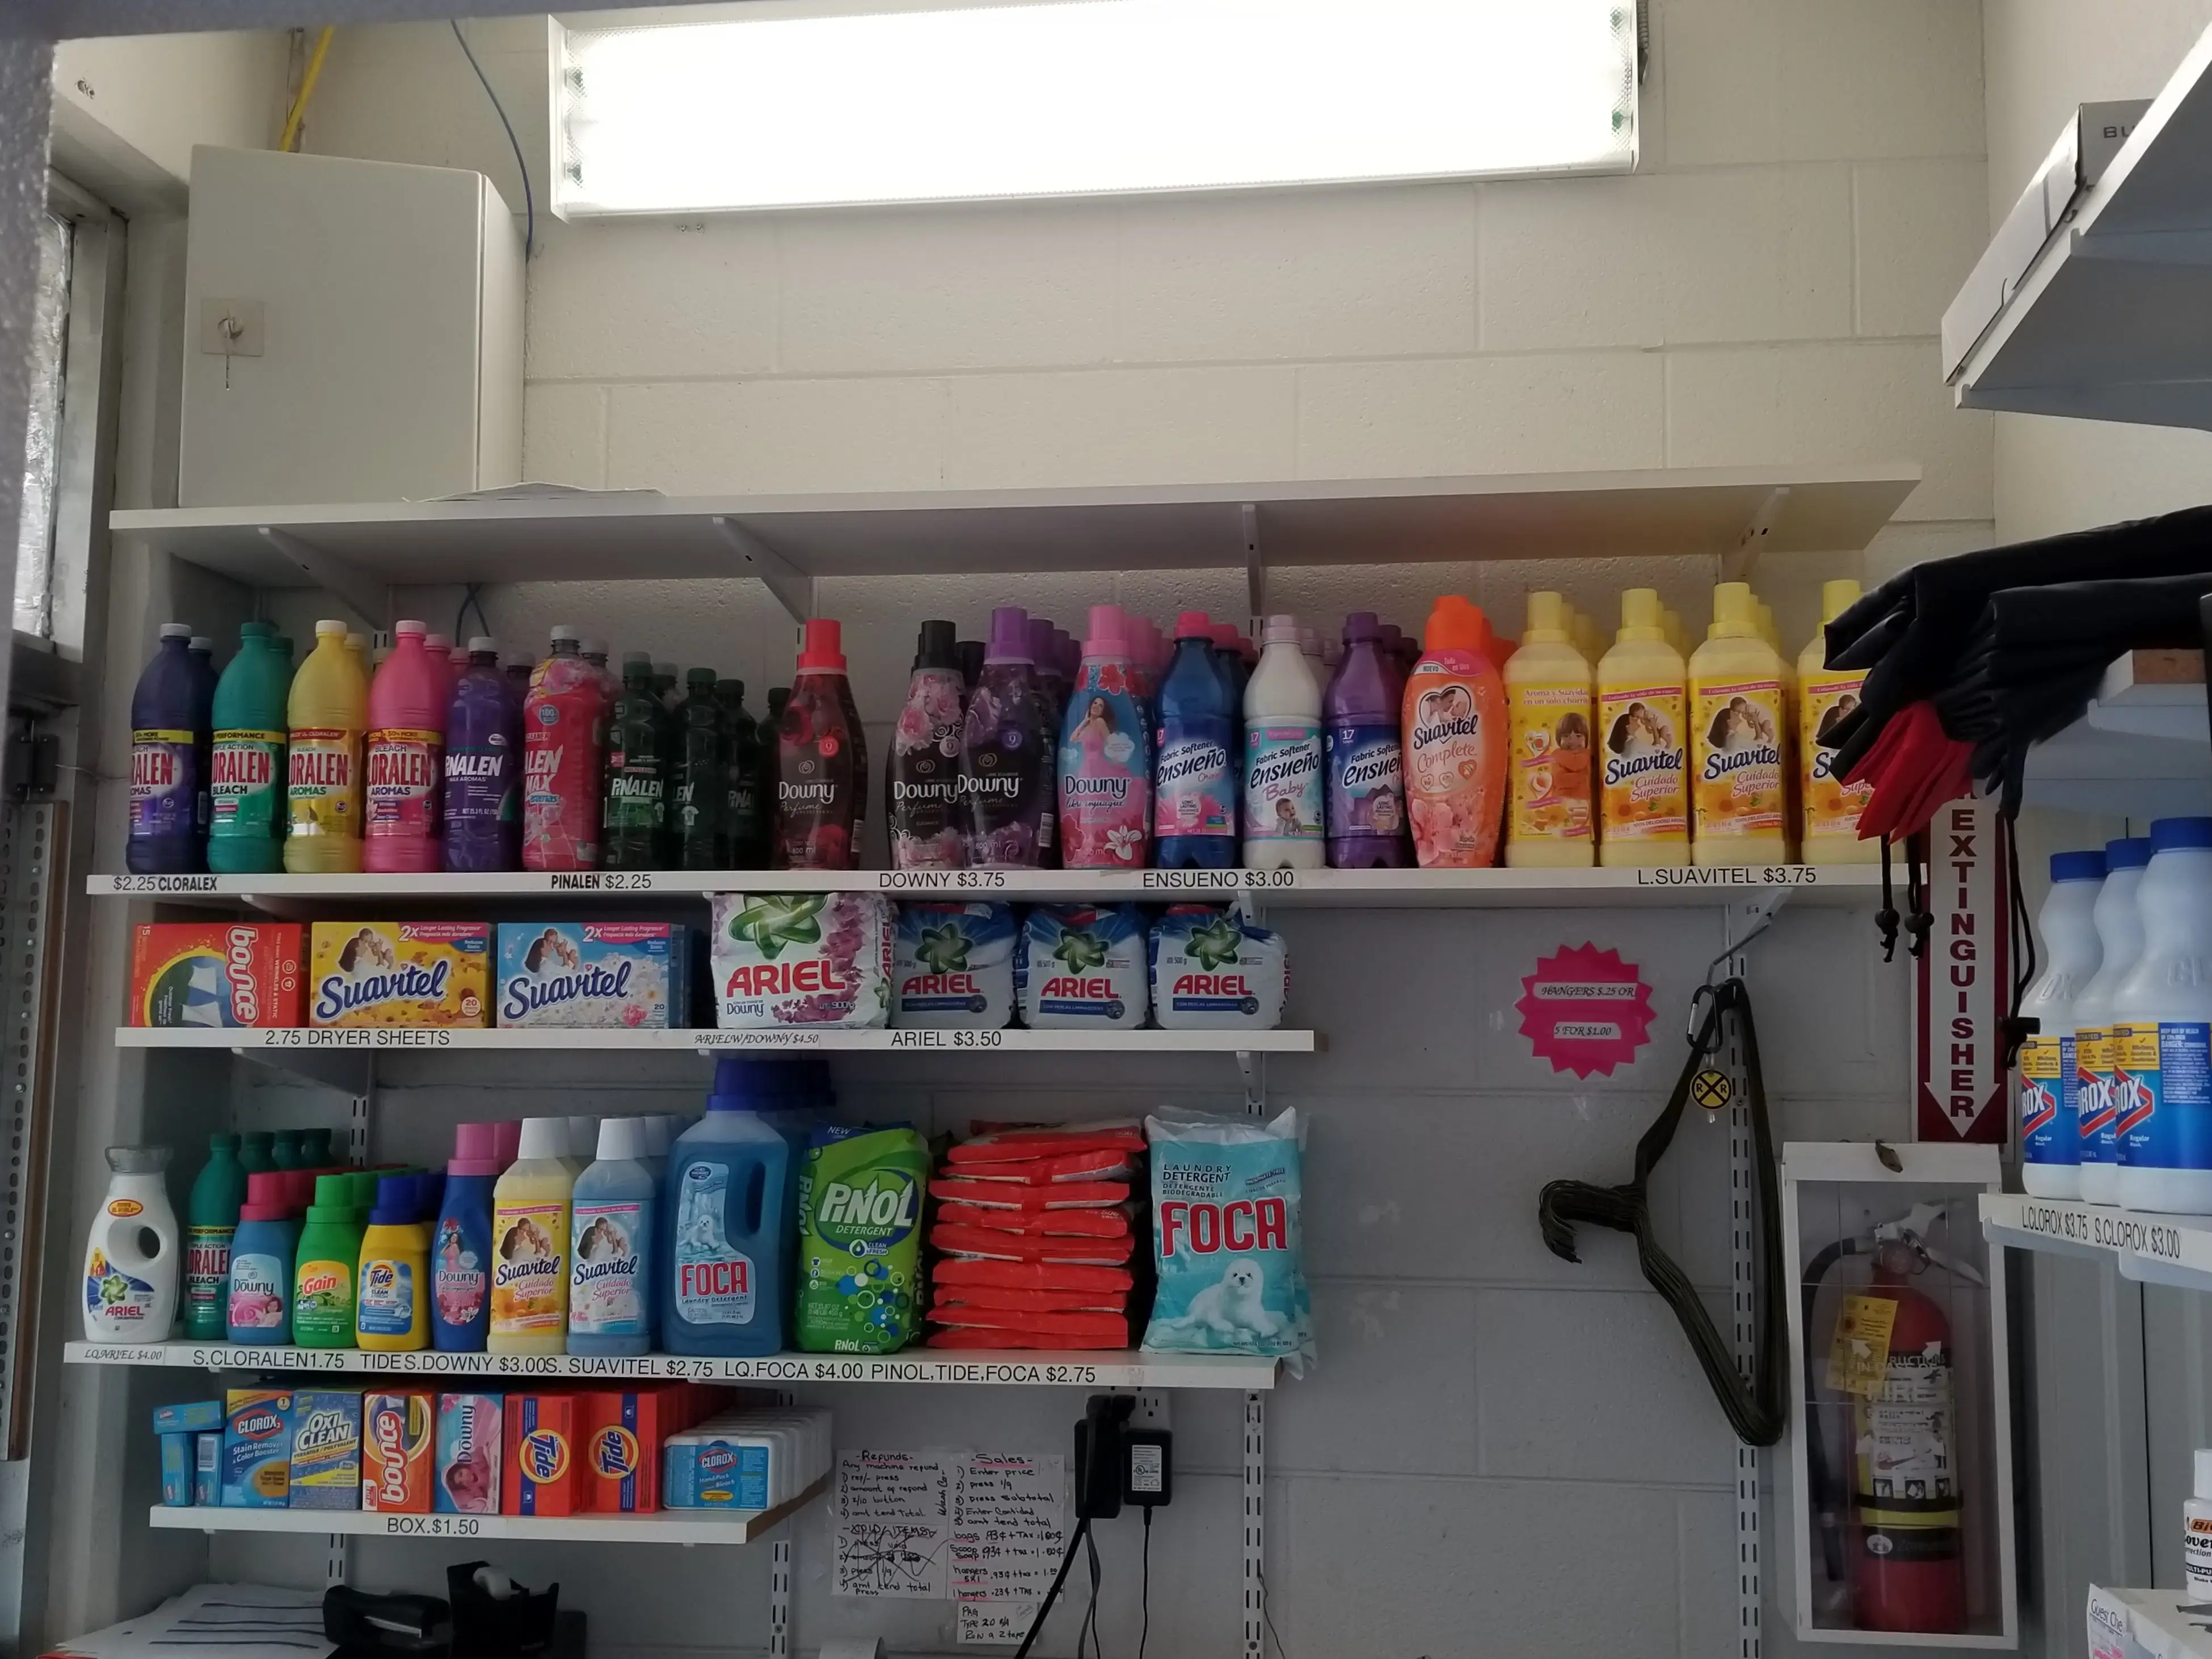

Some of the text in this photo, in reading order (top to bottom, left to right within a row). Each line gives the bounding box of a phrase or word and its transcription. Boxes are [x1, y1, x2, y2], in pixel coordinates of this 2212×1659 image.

[1342, 729, 1355, 740] 17
[1413, 714, 1479, 750] Suavitel
[1160, 740, 1214, 764] Fabric Softener
[1255, 742, 1311, 766] Fabric Softener
[1351, 749, 1375, 764] Fabric
[1417, 740, 1477, 774] Complete
[1156, 750, 1227, 787] ensueño
[1604, 747, 1683, 786] Suavitel
[1704, 742, 1781, 780] Suavitel
[1250, 751, 1320, 790] ensueño
[1737, 771, 1779, 787] Cuidado
[213, 786, 248, 795] BLEACH
[290, 787, 327, 795] AROMAS
[371, 787, 411, 795] AROMAS
[957, 774, 1020, 799] Downy
[1065, 775, 1127, 797] Downy
[1634, 774, 1678, 791] Cuidado
[1732, 780, 1779, 798] Superior
[778, 780, 836, 804] Downy
[893, 780, 959, 804] Downy
[1262, 782, 1305, 801] Baby
[1630, 785, 1682, 803] Superior
[113, 876, 217, 892] $2.25 CLORALEX
[550, 873, 652, 890] PINALEN $2.25
[879, 872, 1005, 888] DOWNY $3.75
[1143, 871, 1294, 888] ENSUENO $3.00
[1637, 867, 1817, 885] L.SUAVITEL $3.75
[398, 925, 419, 942] 2x
[583, 926, 603, 942] 2x
[1949, 809, 1976, 1118] EXTINGUISHER
[228, 927, 258, 1020] bounce
[727, 960, 846, 998] ARIEL
[316, 960, 449, 1019] Suavitel
[503, 961, 631, 1020] Suavitel
[901, 974, 981, 995] ARIEL
[1041, 978, 1119, 999] ARIEL
[1173, 974, 1253, 995] ARIEL
[1541, 985, 1596, 997] HANGERS
[1617, 987, 1636, 997] OR
[726, 1002, 764, 1018] Downy
[266, 1030, 450, 1045] 2.75 DRYER SHEETS
[694, 1033, 819, 1045] ARIELW/DOWNY $4.50
[1554, 1025, 1612, 1036] 5 FOR $1.00
[891, 1031, 1002, 1048] ARIEL $3.50
[828, 1126, 852, 1135] NEW
[1164, 1164, 1232, 1172] LAUNDRY
[1163, 1171, 1231, 1184] DETERGENT
[1163, 1183, 1215, 1192] DETERGENTE
[1163, 1189, 1223, 1198] BIODEGRADABLE
[835, 1225, 893, 1237] DETERGENT
[1161, 1196, 1288, 1258] FOCA
[2021, 1206, 2181, 1260] L.CLOROX $3.75 S.CLOROX $3.00
[369, 1269, 394, 1287] Tide
[439, 1270, 479, 1286] Downy
[495, 1255, 561, 1286] Suavitel
[573, 1255, 639, 1285] Suavitel
[681, 1260, 749, 1297] FOCA
[189, 1276, 219, 1285] BLEACH
[234, 1278, 275, 1297] Downy
[302, 1276, 338, 1295] Gain
[518, 1277, 554, 1290] Cuidado
[596, 1277, 631, 1289] Cuidado
[515, 1287, 557, 1302] Superior
[592, 1287, 633, 1302] Superior
[104, 1305, 146, 1316] ARIEL
[137, 1350, 162, 1361] $4.00
[568, 1359, 660, 1375] SUAVITEL
[666, 1361, 713, 1377] $2.75
[725, 1362, 809, 1378] LQ.FOCA
[815, 1363, 863, 1379] $4.00
[1046, 1367, 1096, 1383] $2.75
[310, 1412, 340, 1433] OXI
[297, 1424, 351, 1451] CLEAN
[457, 1405, 476, 1463] Downy
[233, 1444, 252, 1455] Stain
[323, 1440, 357, 1451] POLYVALENT
[601, 1430, 627, 1475] Tide
[237, 1448, 280, 1462] Color Booster
[381, 1413, 403, 1504] bounce
[528, 1433, 559, 1478] Tide
[701, 1451, 734, 1468] CLOROX
[842, 1459, 860, 1472] Any
[970, 1467, 1035, 1478] Enter price
[970, 1481, 995, 1490] press
[873, 1494, 905, 1504] button
[994, 1516, 1052, 1529] tend total
[954, 1530, 980, 1543] bags
